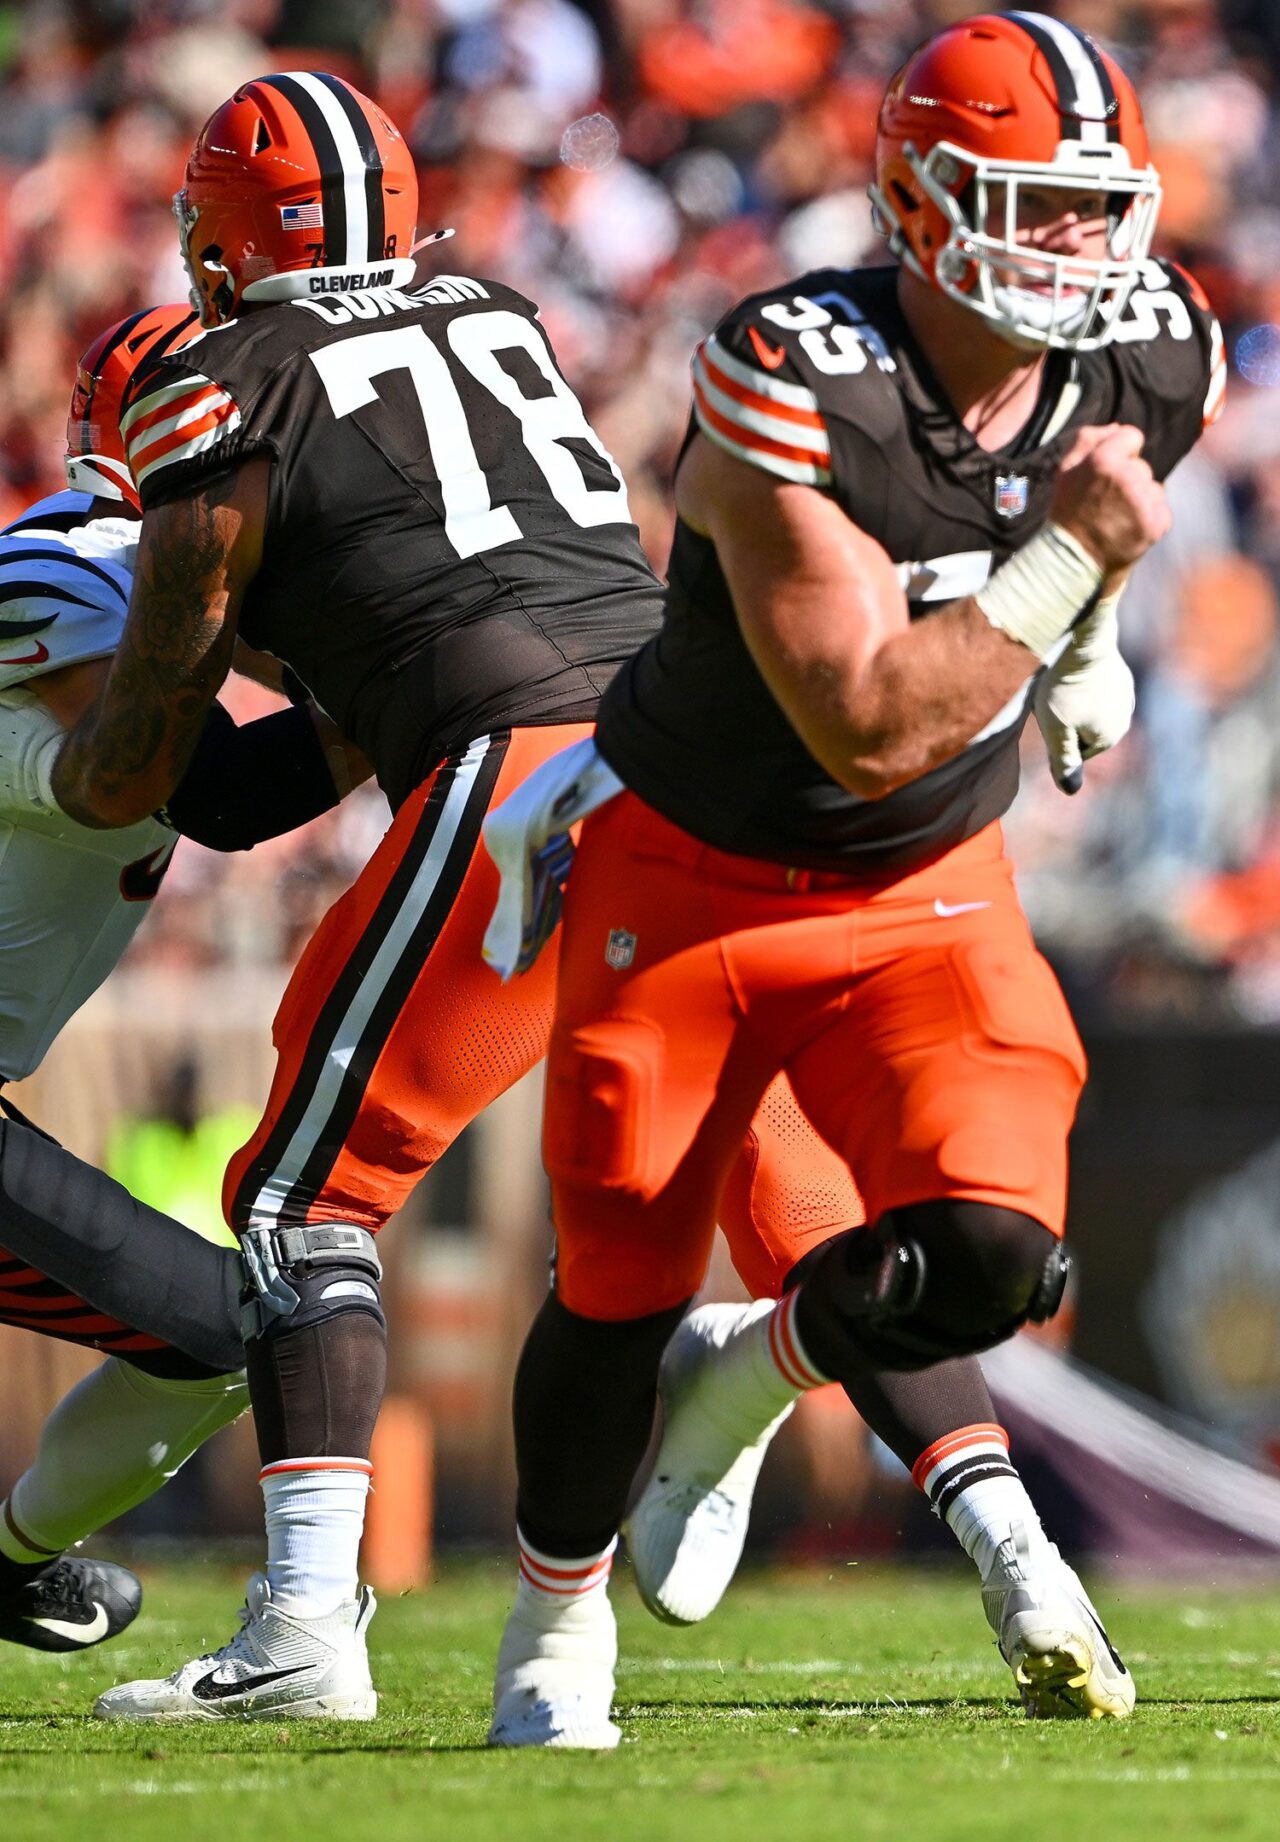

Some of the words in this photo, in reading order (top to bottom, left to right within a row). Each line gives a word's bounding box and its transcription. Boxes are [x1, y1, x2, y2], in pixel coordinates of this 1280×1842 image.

[309, 269, 395, 293] CLEVELAND
[760, 290, 897, 376] 55
[308, 310, 633, 560] 78
